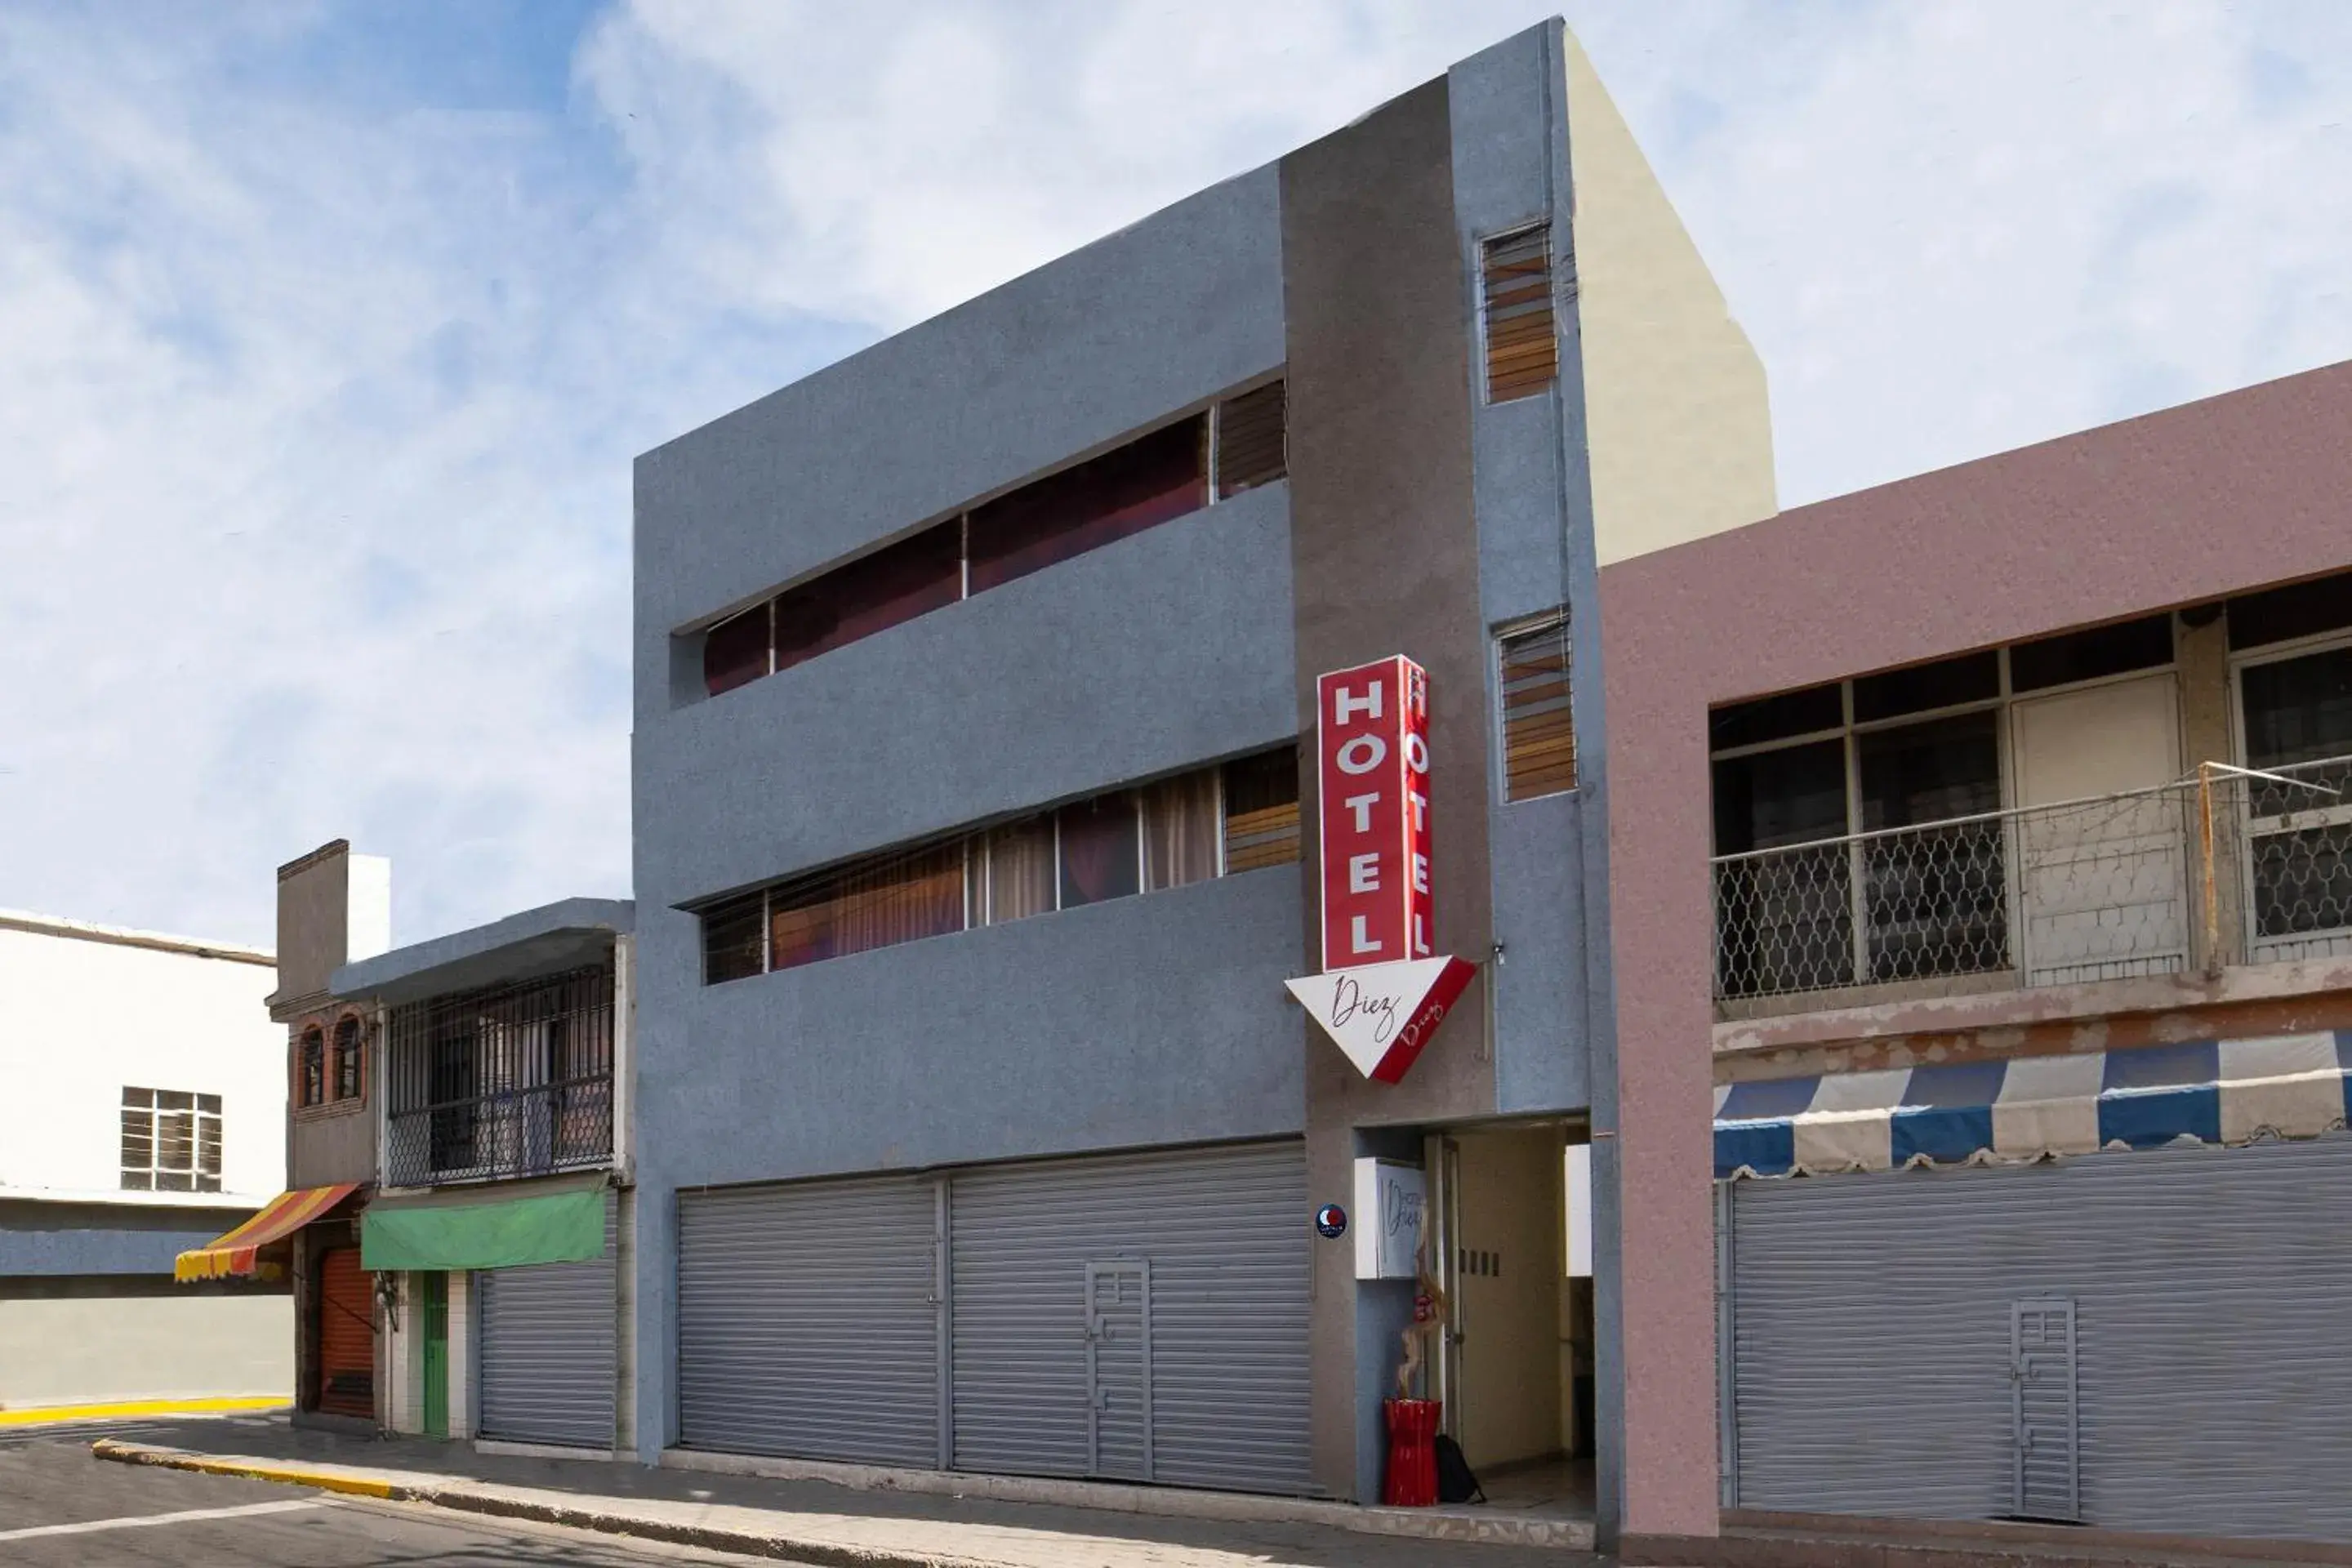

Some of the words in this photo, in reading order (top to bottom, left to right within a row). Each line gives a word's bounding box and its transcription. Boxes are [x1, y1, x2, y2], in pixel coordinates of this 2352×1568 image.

[1335, 680, 1387, 954] HOTEL
[1405, 665, 1429, 955] HOTEL
[1332, 975, 1402, 1043] Diez
